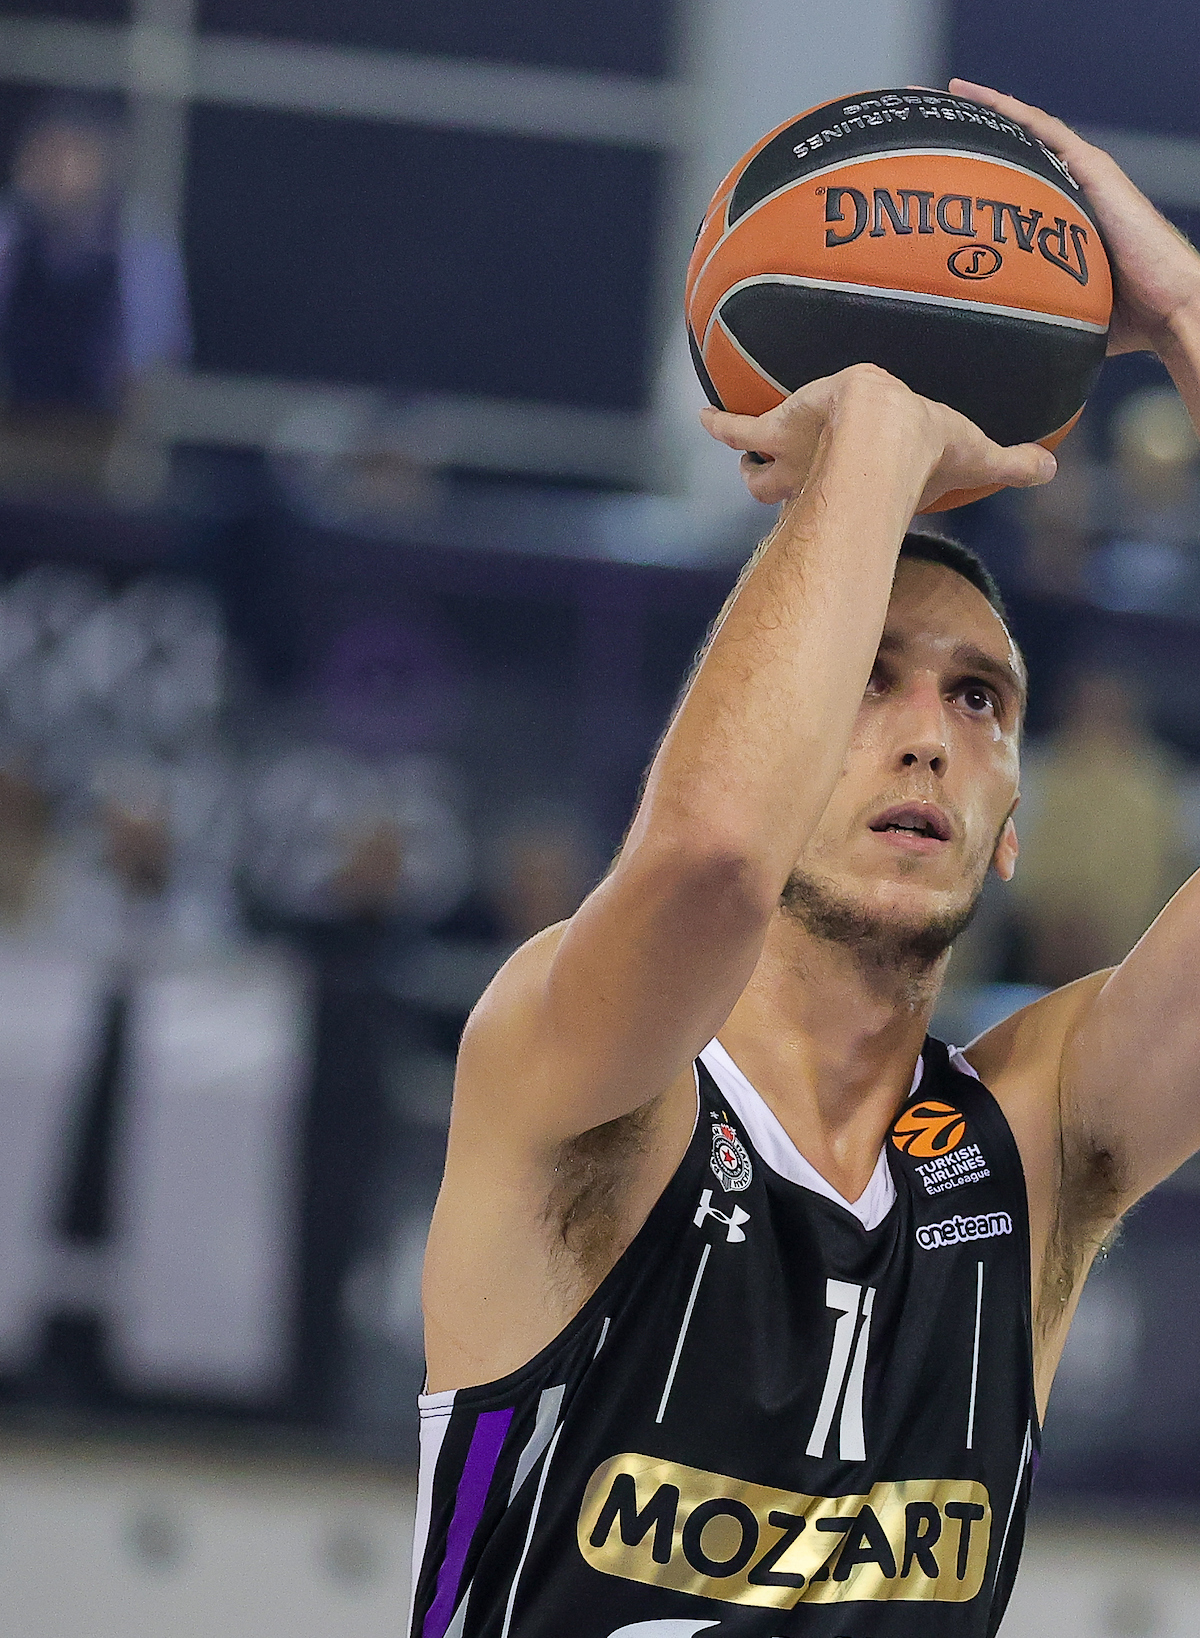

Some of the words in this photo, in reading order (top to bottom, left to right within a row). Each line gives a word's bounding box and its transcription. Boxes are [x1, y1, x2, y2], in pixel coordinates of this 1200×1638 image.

[792, 107, 910, 159] AIRLINES
[919, 106, 1032, 147] TURKISH
[824, 186, 1089, 287] SPALDING
[915, 1143, 981, 1177] TURKISH
[923, 1155, 986, 1187] AIRLINES
[926, 1168, 991, 1195] EuroLeague
[916, 1211, 1013, 1250] oneteam
